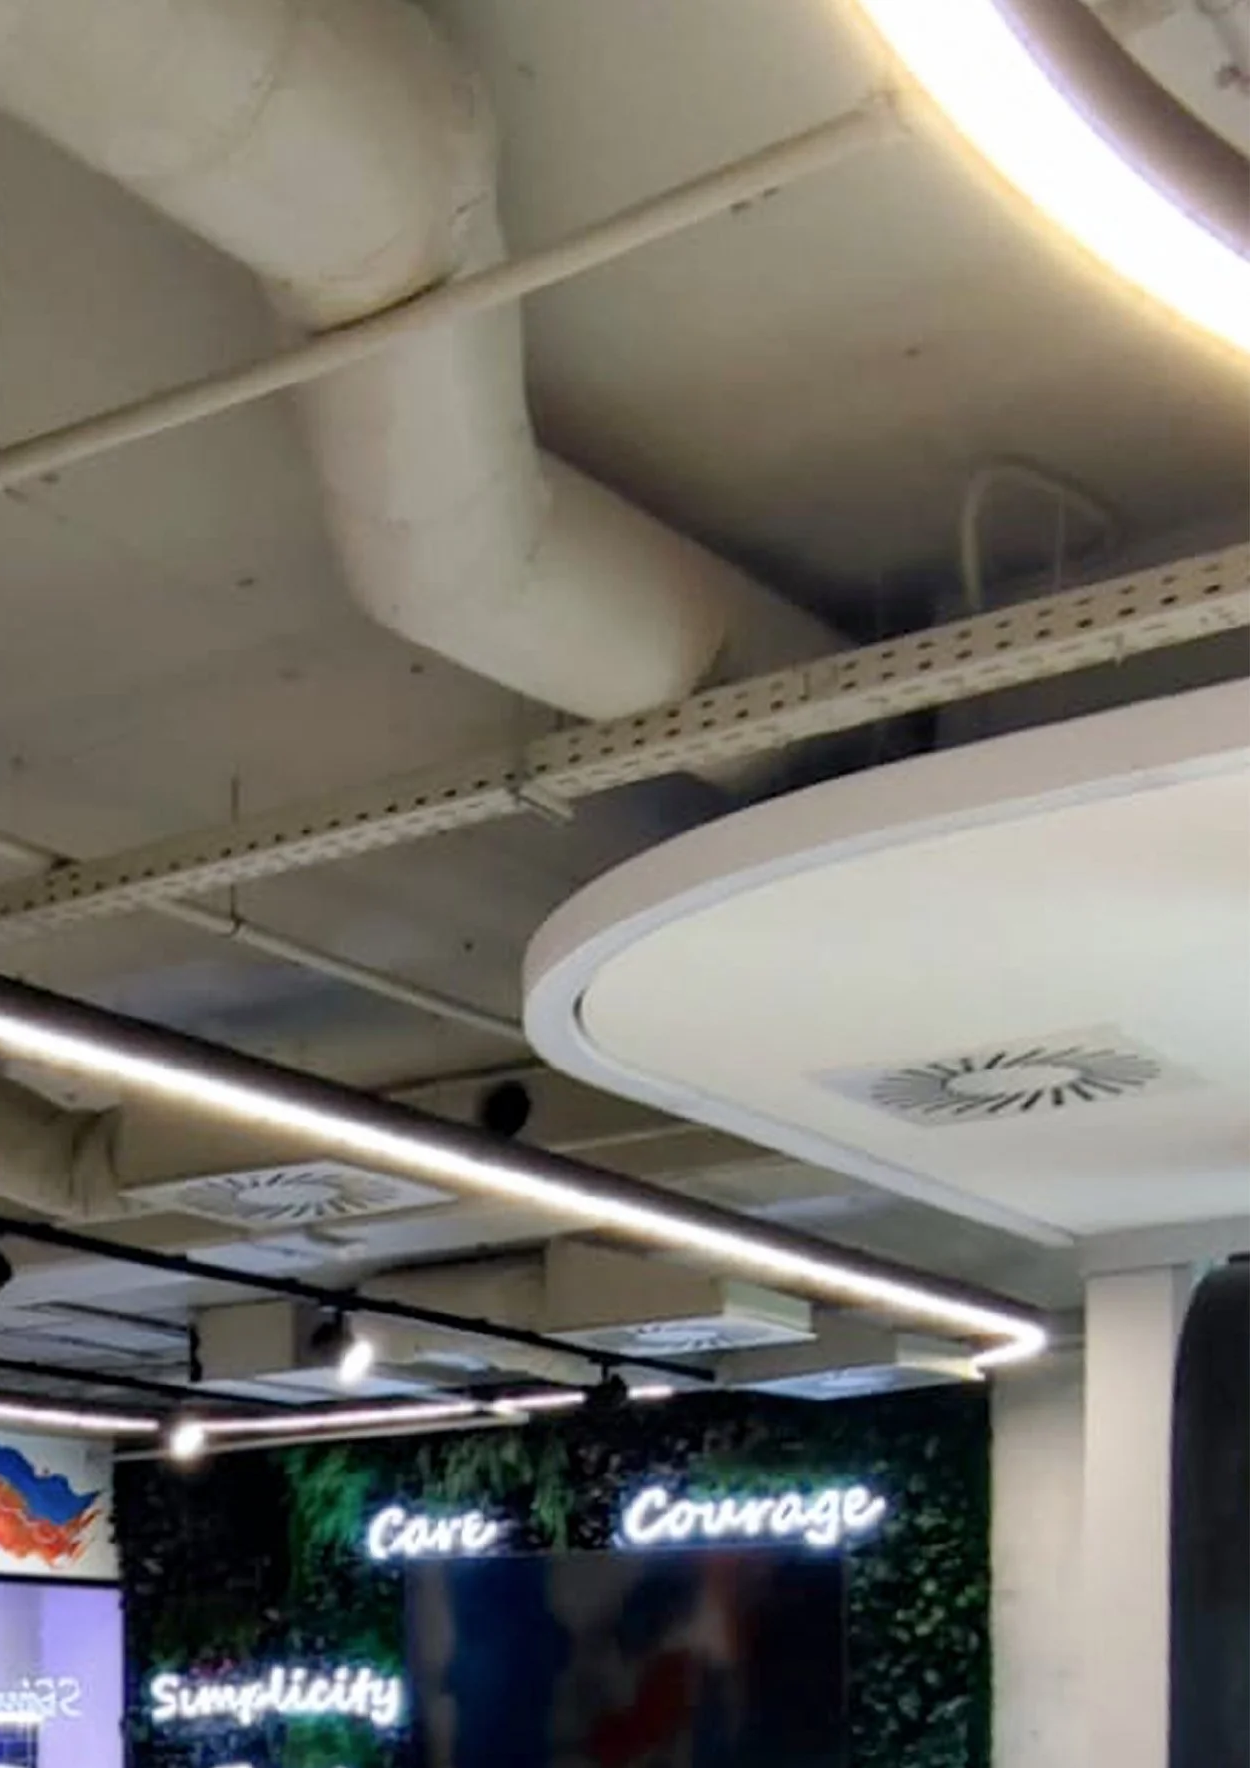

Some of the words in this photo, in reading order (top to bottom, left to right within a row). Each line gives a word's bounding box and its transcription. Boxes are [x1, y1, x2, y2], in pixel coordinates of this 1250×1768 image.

[368, 1504, 498, 1559] Care
[623, 1486, 884, 1546] Courage
[150, 1666, 401, 1726] Simplicity
